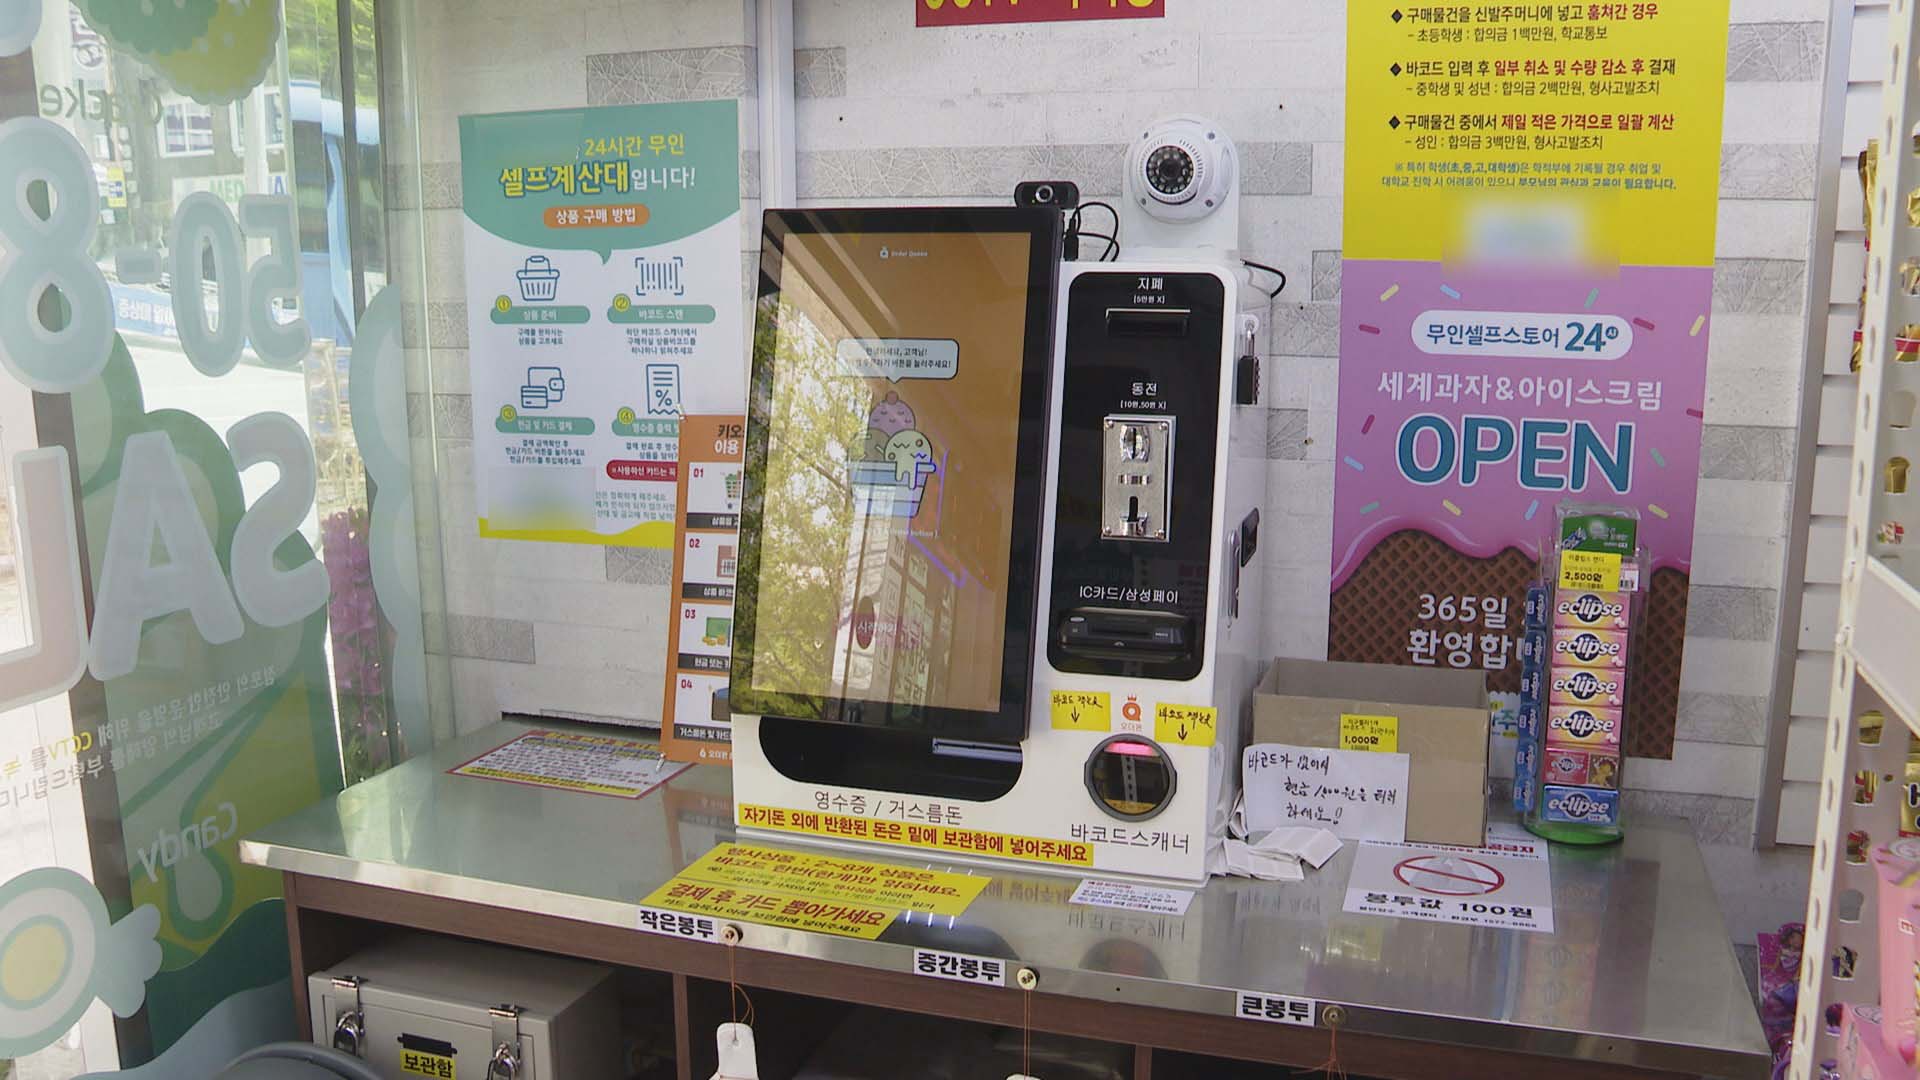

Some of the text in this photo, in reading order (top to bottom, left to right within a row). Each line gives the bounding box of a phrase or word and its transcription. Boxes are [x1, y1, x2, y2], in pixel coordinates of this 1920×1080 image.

[1407, 3, 1659, 23] 구매물건을 신발주머니에 넣고 훔쳐간 경우
[1417, 26, 1608, 43] 초등학생 합의금 1백만원, 학교통보
[1406, 61, 1444, 77] 바코드
[1448, 60, 1473, 77] 입력
[1476, 60, 1490, 76] 후
[1494, 60, 1520, 77] 일부
[1524, 60, 1550, 76] 취소
[1554, 59, 1567, 76] 및
[1570, 59, 1597, 76] 수량
[1601, 59, 1627, 76] 감소
[1631, 58, 1645, 75] 후
[1416, 81, 1660, 97] 중학생 및 성년 합의금 2백만원, 형사고발조치
[1404, 114, 1674, 131] 구매물건 중에서 제일 적은 가격으로 일괄 계산
[585, 133, 685, 157] 24시간 무인
[1415, 135, 1604, 151] 성인 합의금 3백만원, 형사고발조치
[499, 161, 696, 198] 셀프계산대입니다!
[555, 207, 636, 226] 상품 구매 방법
[1137, 277, 1164, 291] 지폐
[1427, 323, 1561, 349] 무인셀프스토어
[1131, 382, 1158, 397] 동전
[1377, 370, 1663, 412] 세계과자&아이스크림
[717, 424, 744, 439] 키오
[714, 439, 740, 455] 이용
[1395, 412, 1636, 494] OPEN
[693, 467, 704, 478] 01
[689, 538, 700, 549] 02
[1079, 584, 1180, 604] IC카드/삼성페이
[684, 608, 696, 619] 03
[1417, 593, 1509, 630] 365일
[1558, 597, 1624, 622] eclipse
[1407, 628, 1524, 671] 환영합
[1555, 637, 1621, 661] eclipse
[681, 679, 692, 689] 04
[1553, 676, 1618, 700] eclipse
[1550, 714, 1615, 739] eclipse
[1248, 751, 1293, 773] 바코드가
[814, 791, 867, 815] 영수증
[889, 800, 963, 825] 거스름돈
[1548, 795, 1609, 819] eclipse
[744, 807, 1088, 861] 자기돈 외에 반환된 돈은 밑에 보관함에 넣어주세요
[1071, 823, 1190, 854] 바코드스캐너
[714, 855, 767, 870] 바코드
[727, 847, 796, 863] 행사상품
[879, 868, 935, 881] 상품은
[666, 883, 886, 926] 결제 후 카드 뽑아가세요
[1364, 892, 1444, 910] 봉투값
[1458, 902, 1534, 919] 100원
[640, 909, 714, 939] 작은봉투
[917, 952, 1002, 983] 중간봉투
[1241, 995, 1311, 1022] 큰봉투
[403, 1053, 454, 1079] 보관함
